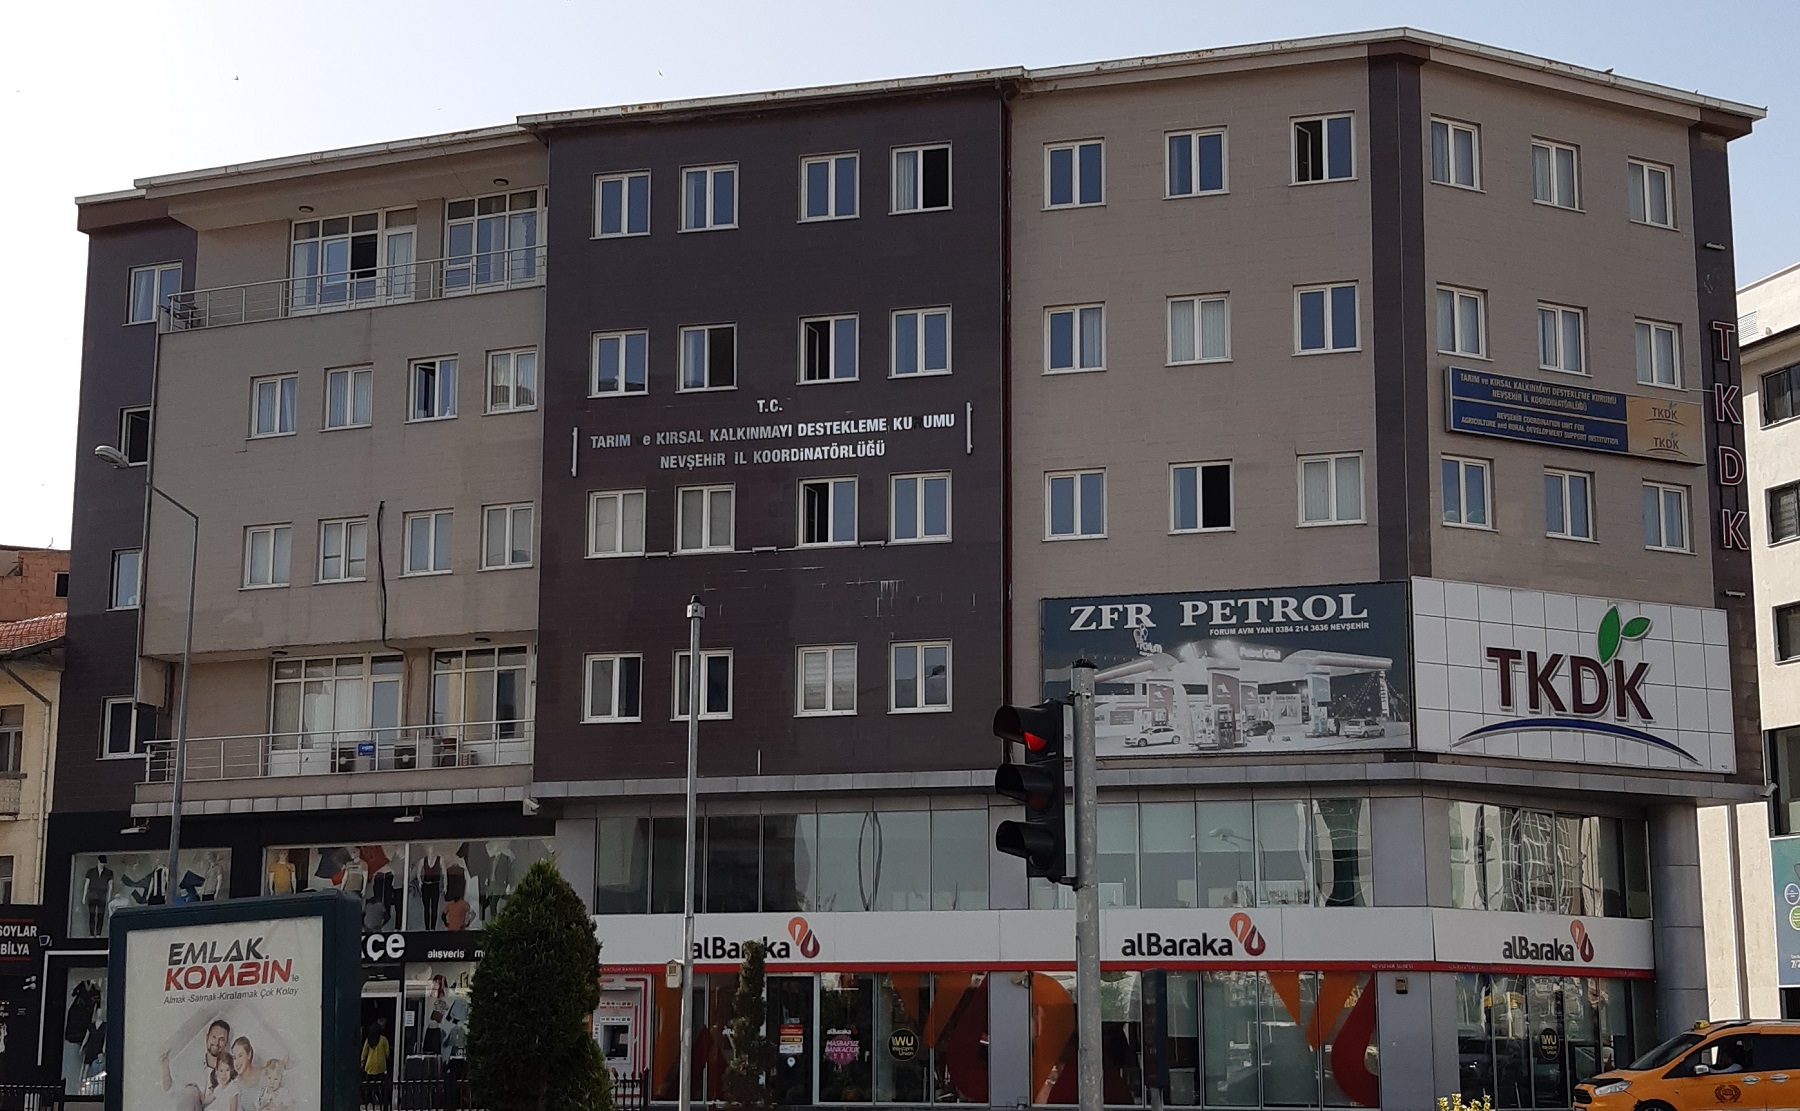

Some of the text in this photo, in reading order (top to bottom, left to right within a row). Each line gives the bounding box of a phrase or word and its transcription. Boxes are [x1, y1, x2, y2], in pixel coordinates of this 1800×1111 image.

[1460, 373, 1480, 383] TARIM
[1490, 377, 1512, 389] KIRSAL
[1552, 388, 1590, 400] DESTEKLEME
[757, 399, 783, 413] T.C.
[1652, 407, 1678, 420] TKDK
[590, 434, 631, 449] TARIM
[656, 430, 704, 445] KIRSAL
[710, 423, 792, 442] KALKINMAYI
[798, 417, 887, 437] DESTEKLEME
[1653, 436, 1679, 450] TKDK
[1712, 320, 1750, 551] TKDK
[1069, 593, 1368, 632] ZFR PETROL
[1209, 628, 1236, 636] FORUM
[1238, 627, 1254, 635] AVM
[1256, 626, 1274, 634] YANI
[1275, 625, 1293, 633] 0384
[1295, 624, 1309, 632] 214
[1486, 646, 1655, 722] TKDK
[168, 937, 263, 966] EMLAK
[361, 933, 406, 961] çe
[693, 936, 790, 959] alBaka
[1121, 932, 1233, 957] alBaraka
[1502, 935, 1574, 961] alBaraka
[165, 955, 292, 991] KOMBİN
